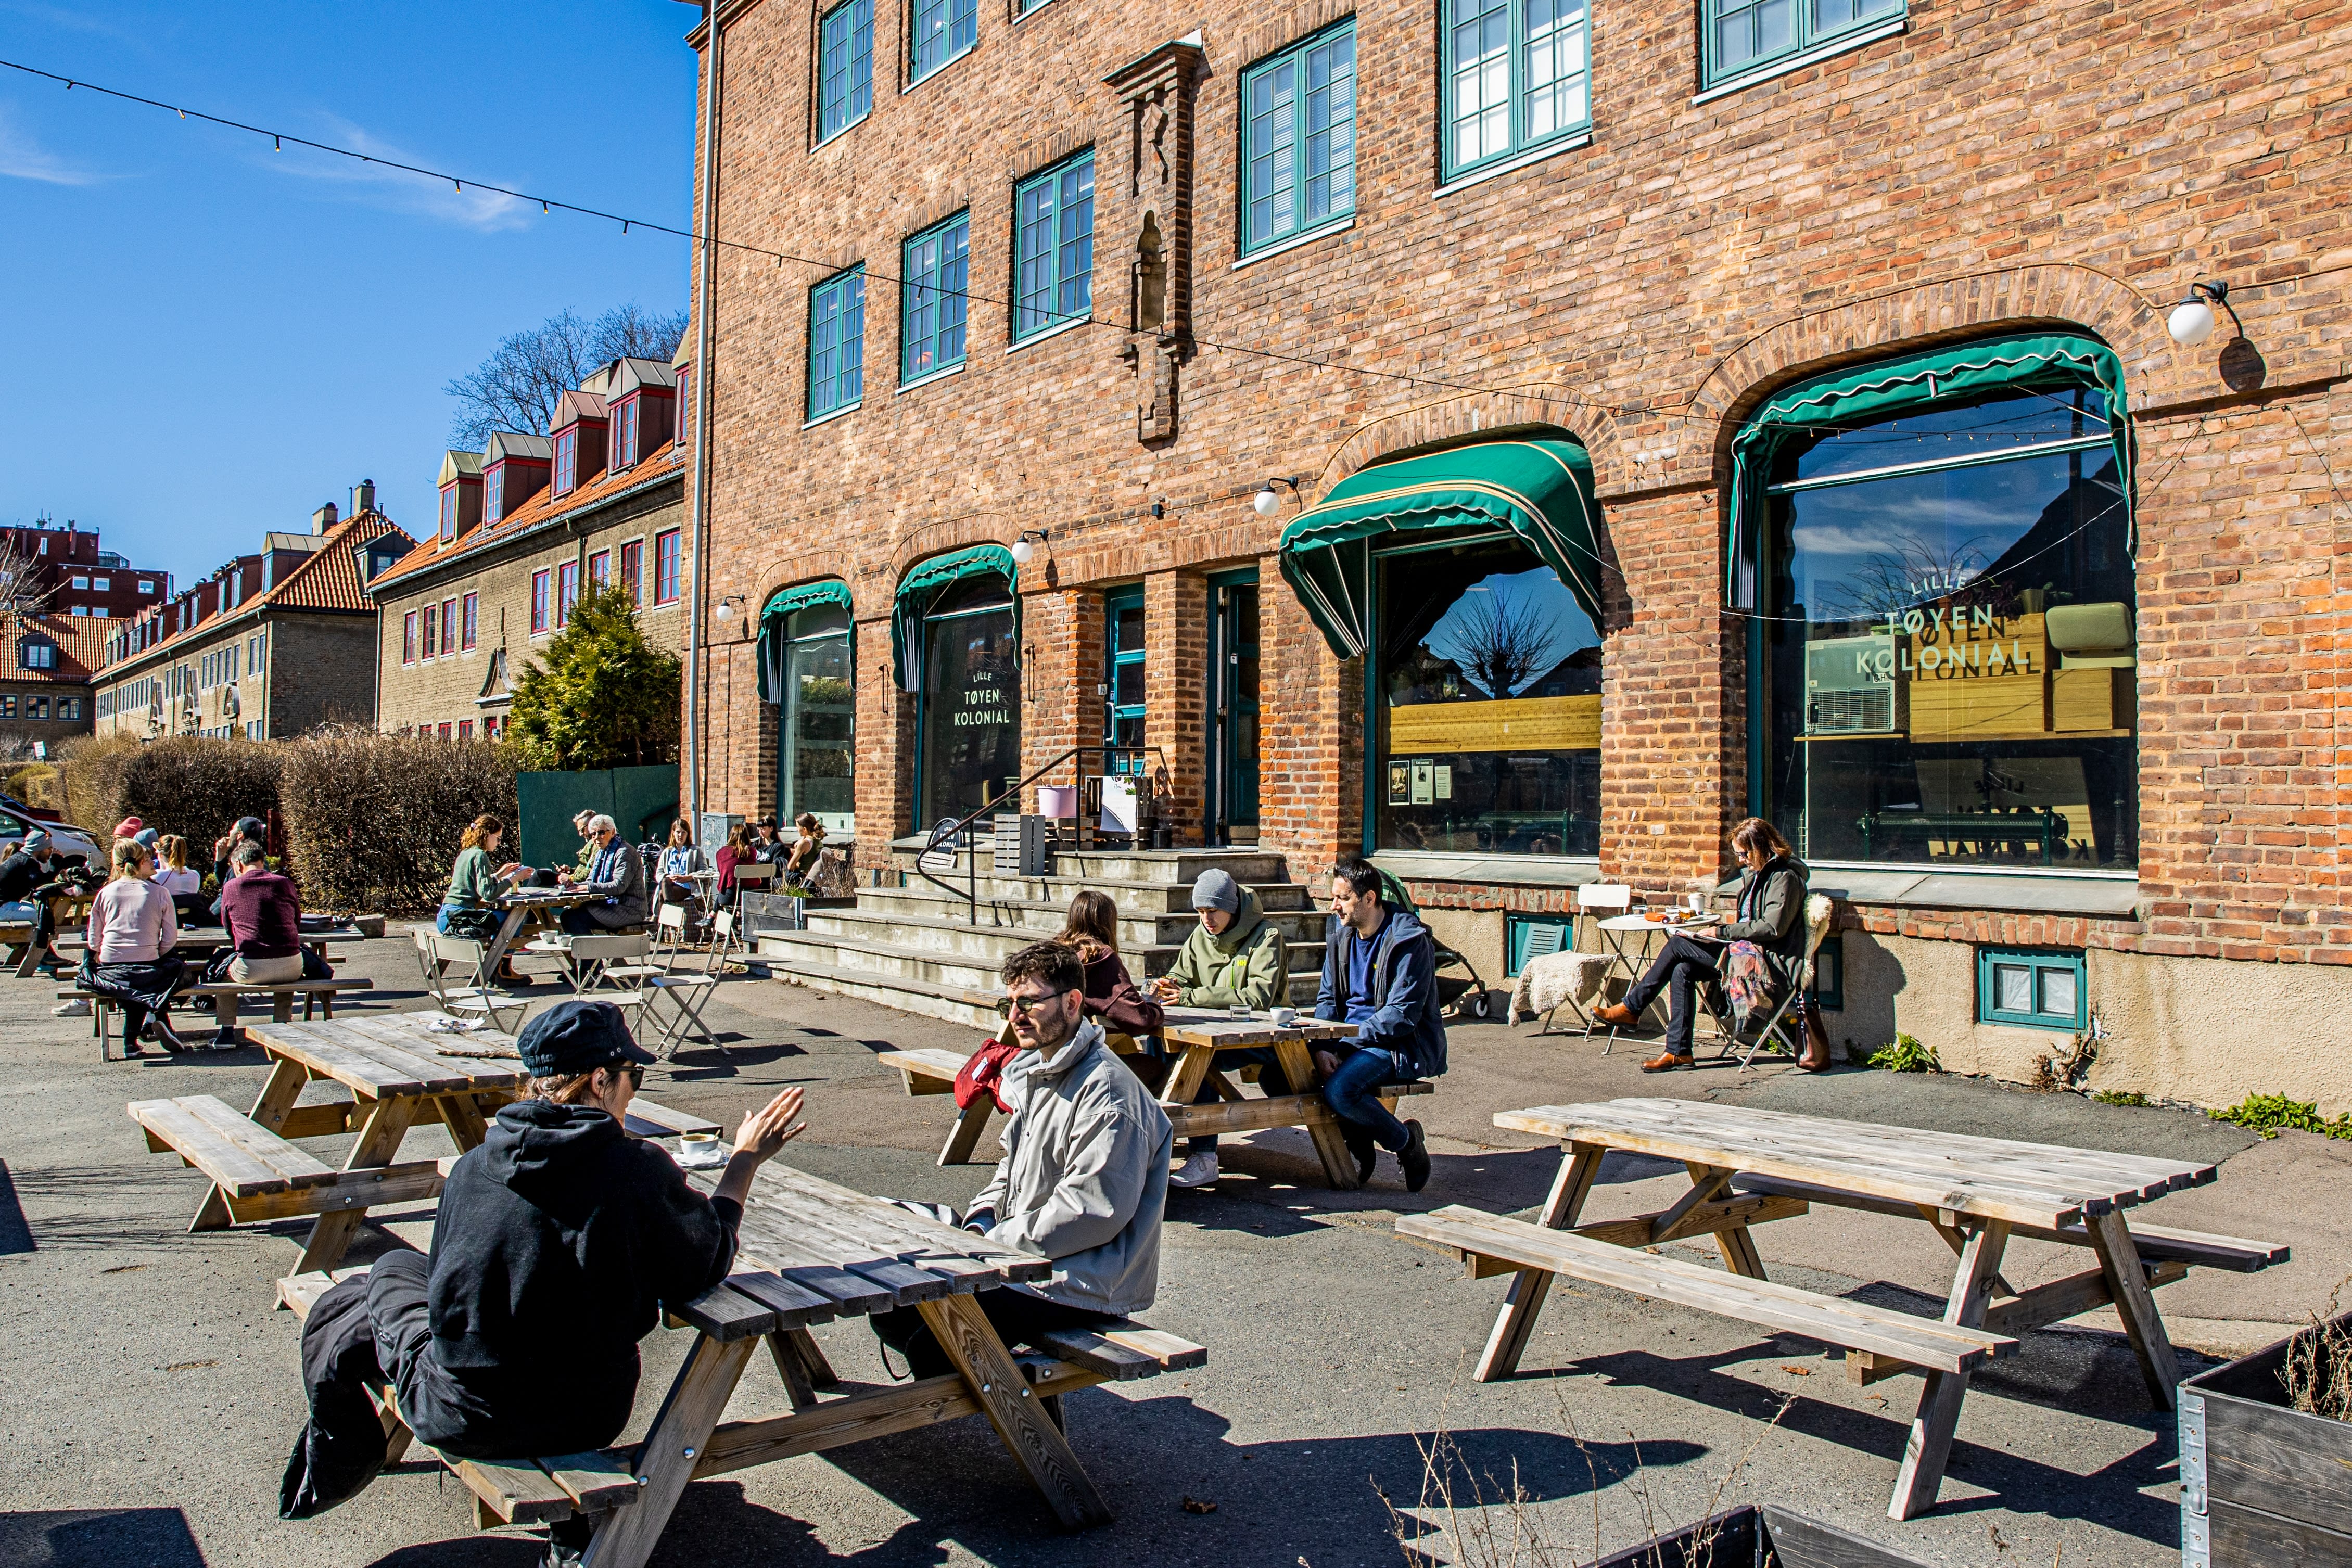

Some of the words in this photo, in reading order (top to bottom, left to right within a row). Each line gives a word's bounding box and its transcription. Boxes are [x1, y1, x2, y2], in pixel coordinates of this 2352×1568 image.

[1910, 574, 1968, 597] LILLE
[1884, 603, 1992, 635] TØYEN
[1855, 641, 2029, 674] KOLONIAL
[973, 671, 992, 683] LILLE
[964, 689, 999, 705] TØYEN
[955, 709, 1010, 726] KOLONIAL
